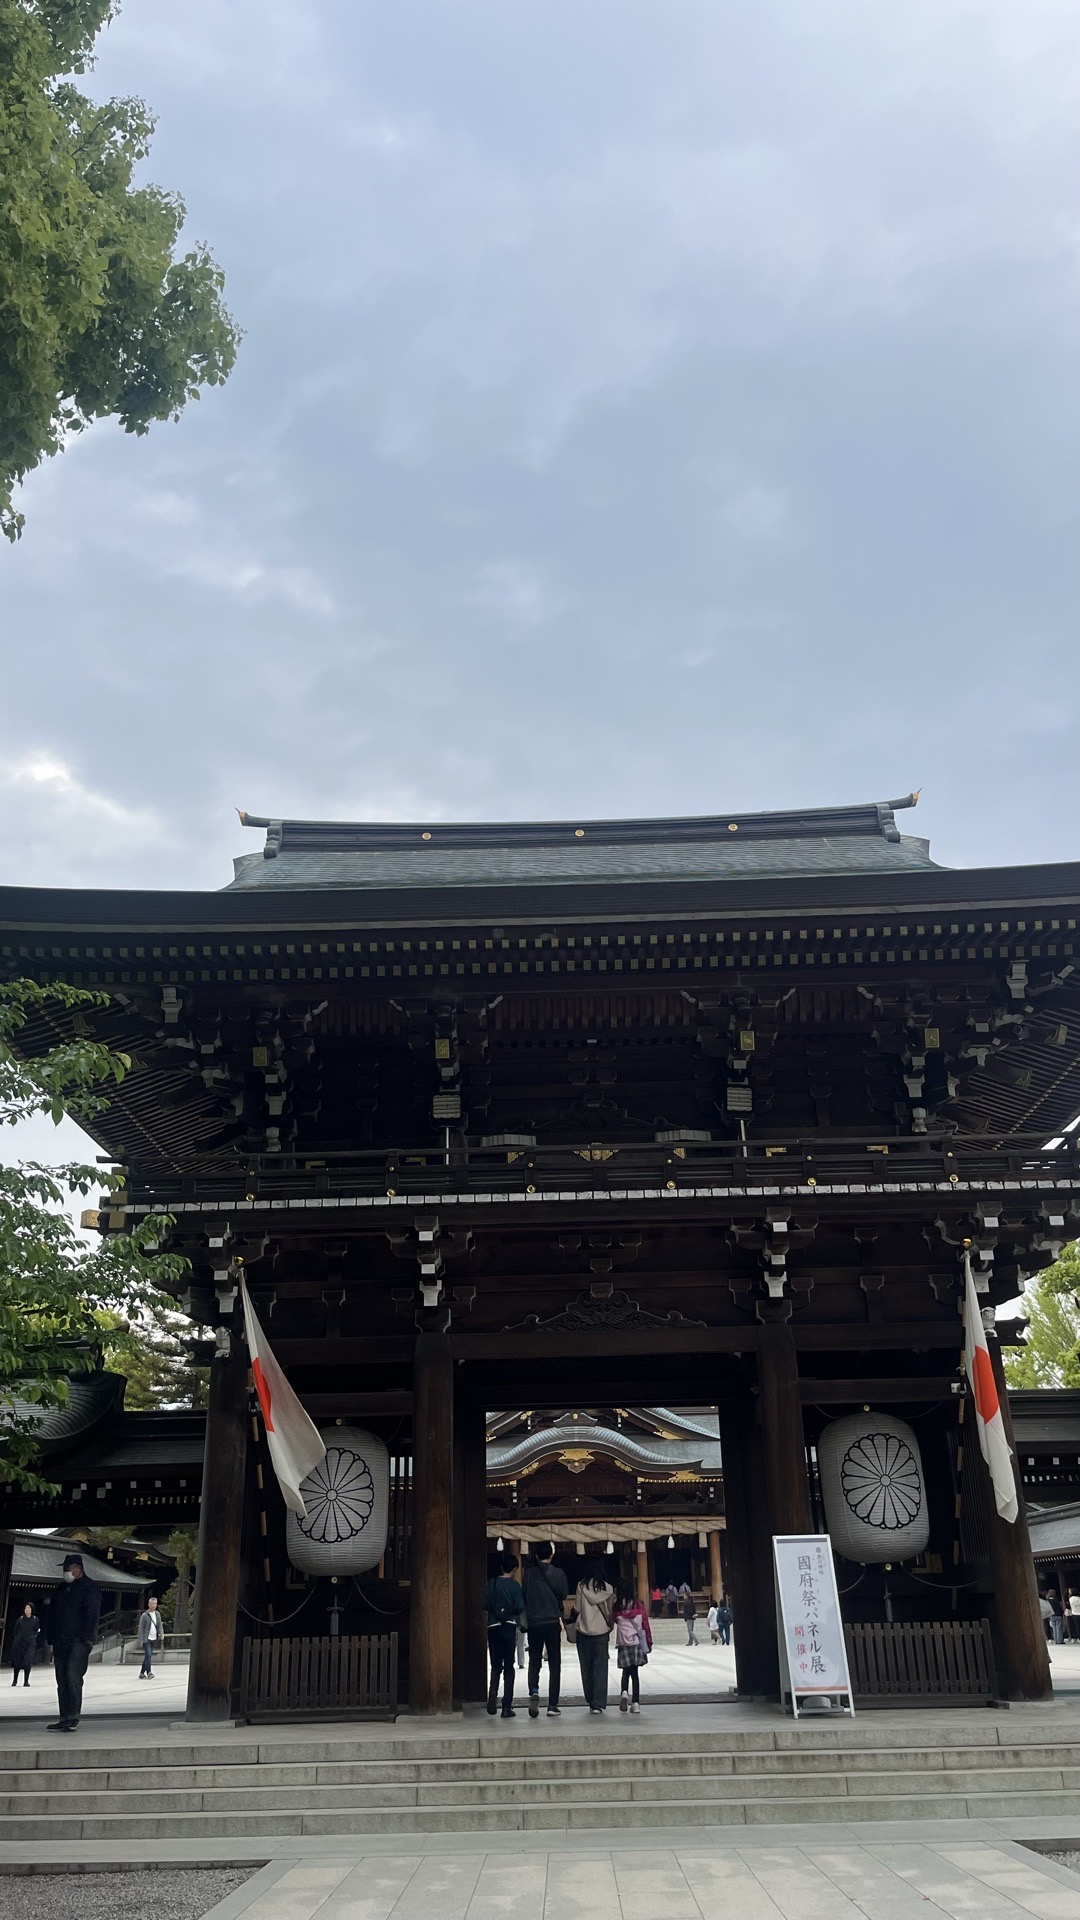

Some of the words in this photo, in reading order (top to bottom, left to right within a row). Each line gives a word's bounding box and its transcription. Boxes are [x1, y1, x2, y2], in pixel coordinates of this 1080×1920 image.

[794, 1626, 808, 1674] 開催中
[797, 1555, 826, 1674] 國府祭パネル展
